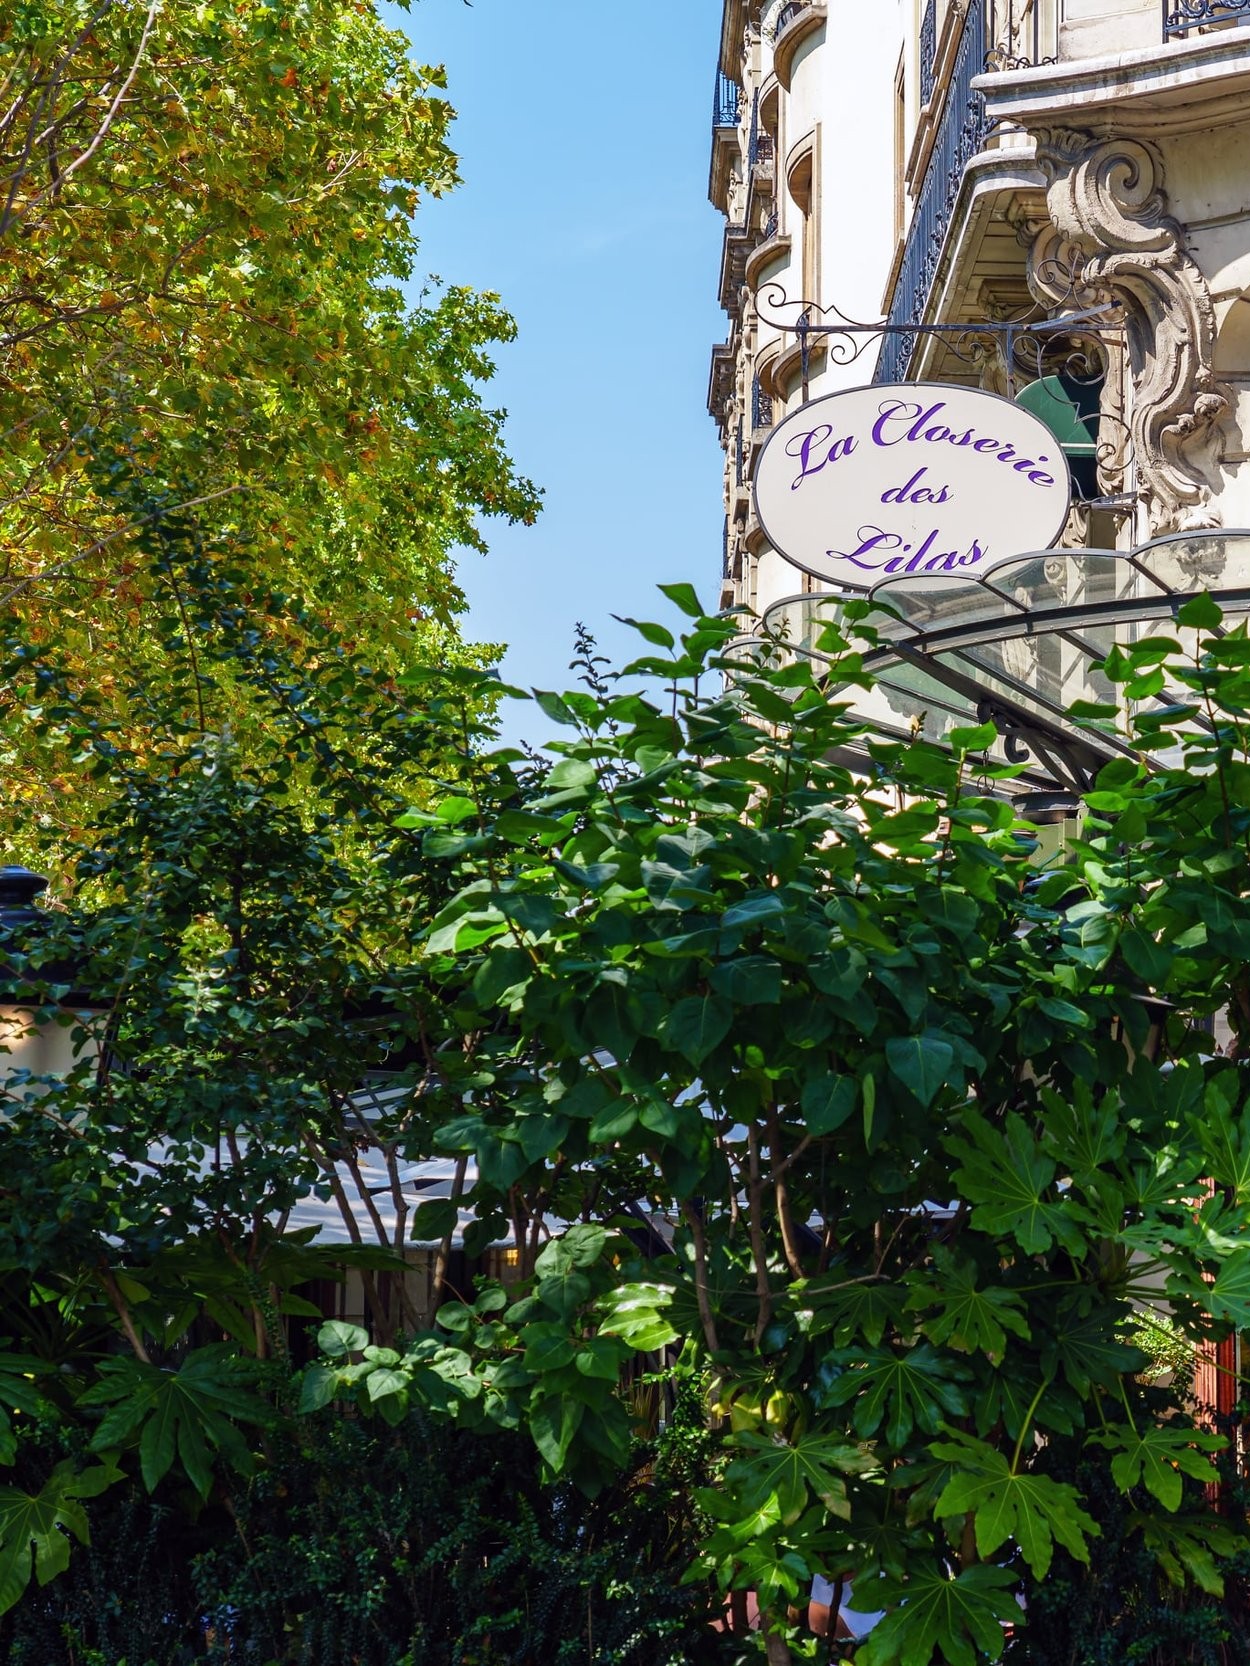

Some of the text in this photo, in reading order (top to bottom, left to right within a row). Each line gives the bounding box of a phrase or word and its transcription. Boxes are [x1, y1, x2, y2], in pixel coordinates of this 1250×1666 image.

[785, 399, 1055, 491] La Closerie
[881, 467, 954, 504] des
[826, 525, 988, 573] Lilas
